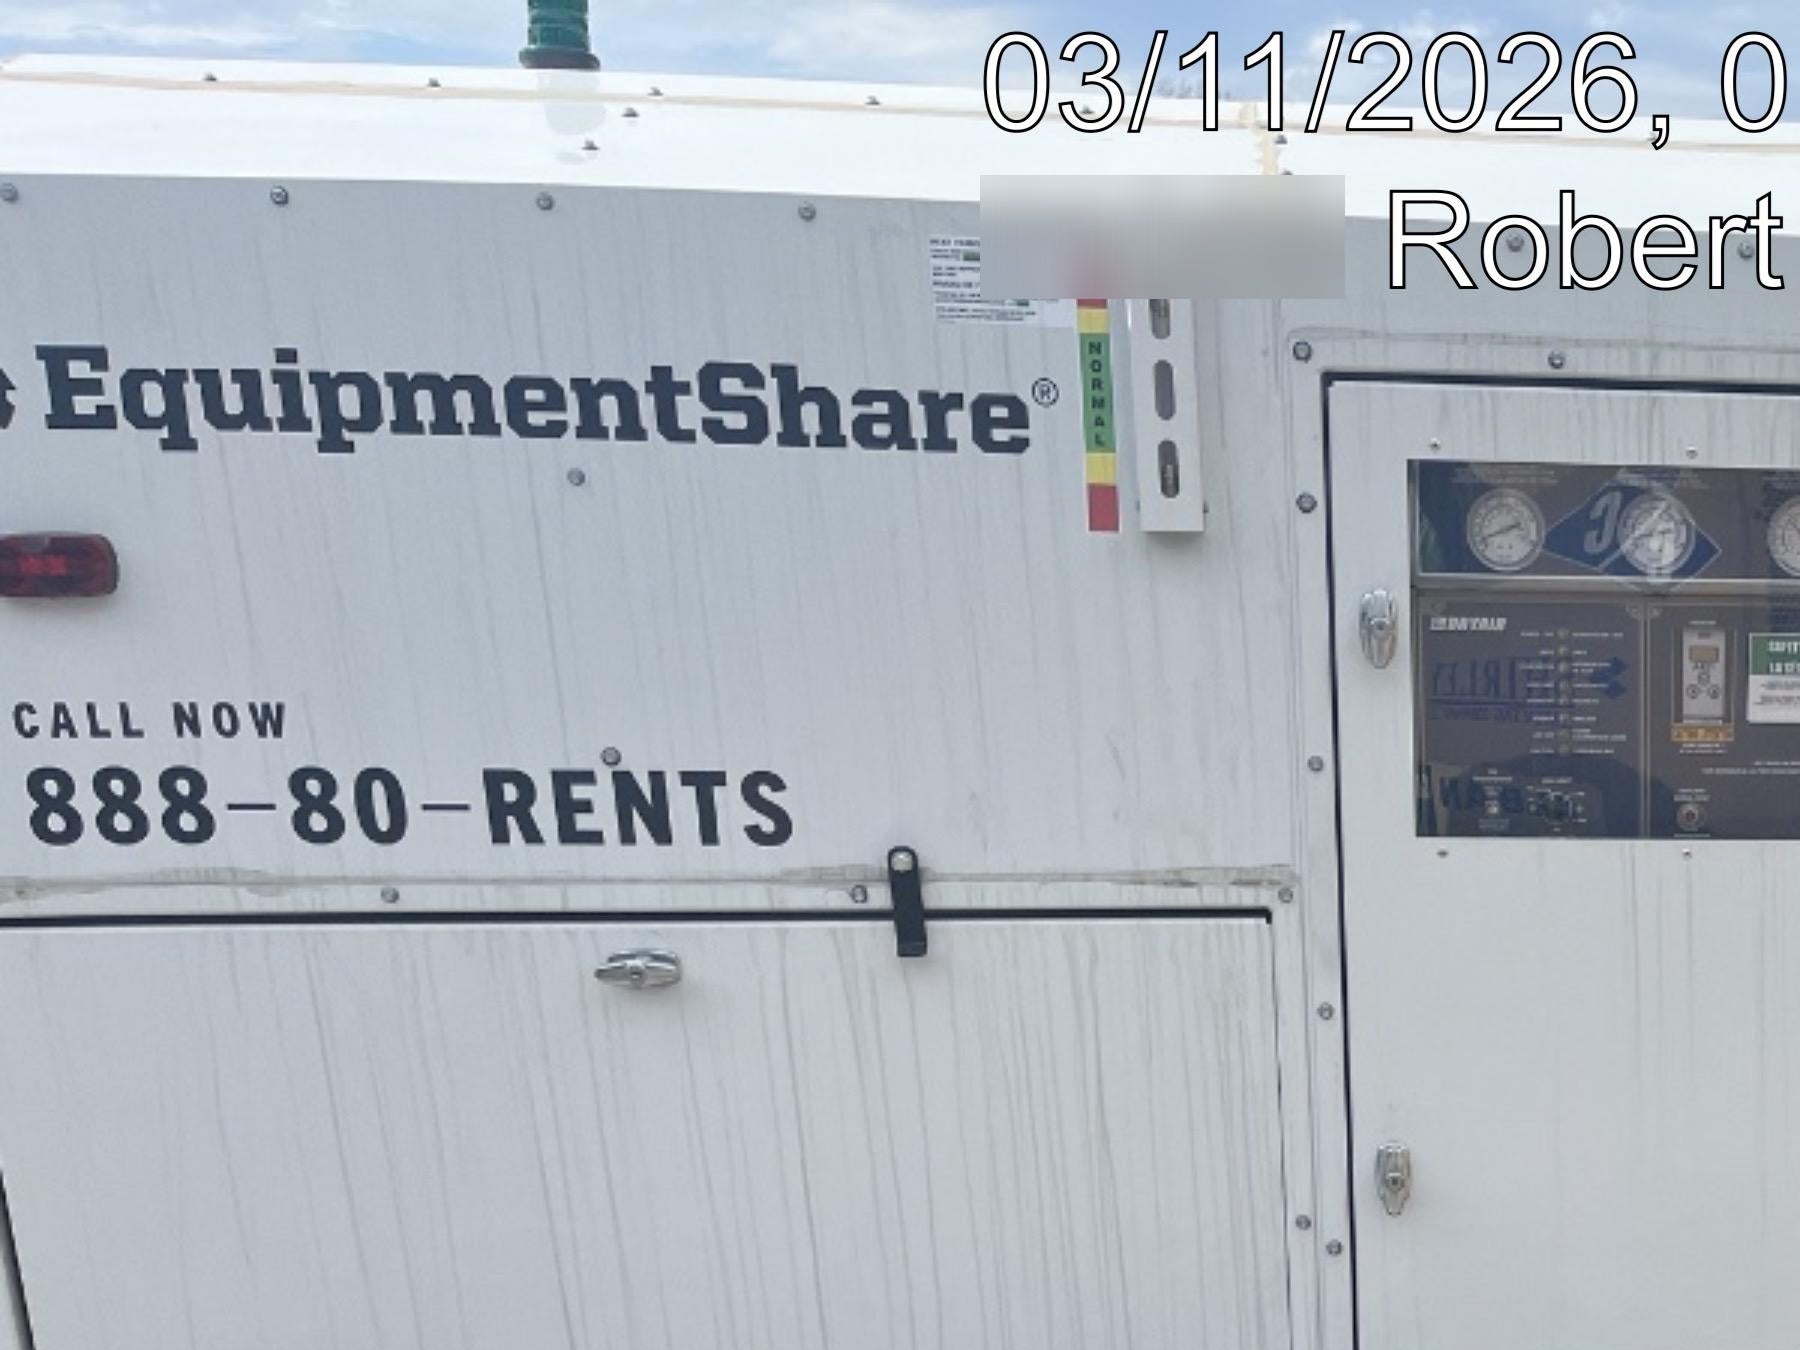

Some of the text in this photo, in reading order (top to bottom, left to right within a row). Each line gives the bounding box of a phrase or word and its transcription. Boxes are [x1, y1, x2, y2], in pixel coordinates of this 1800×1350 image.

[1087, 341, 1105, 447] NORMAL
[12, 702, 286, 739] CALL NOW
[25, 766, 794, 848] 888-80-RENTS
